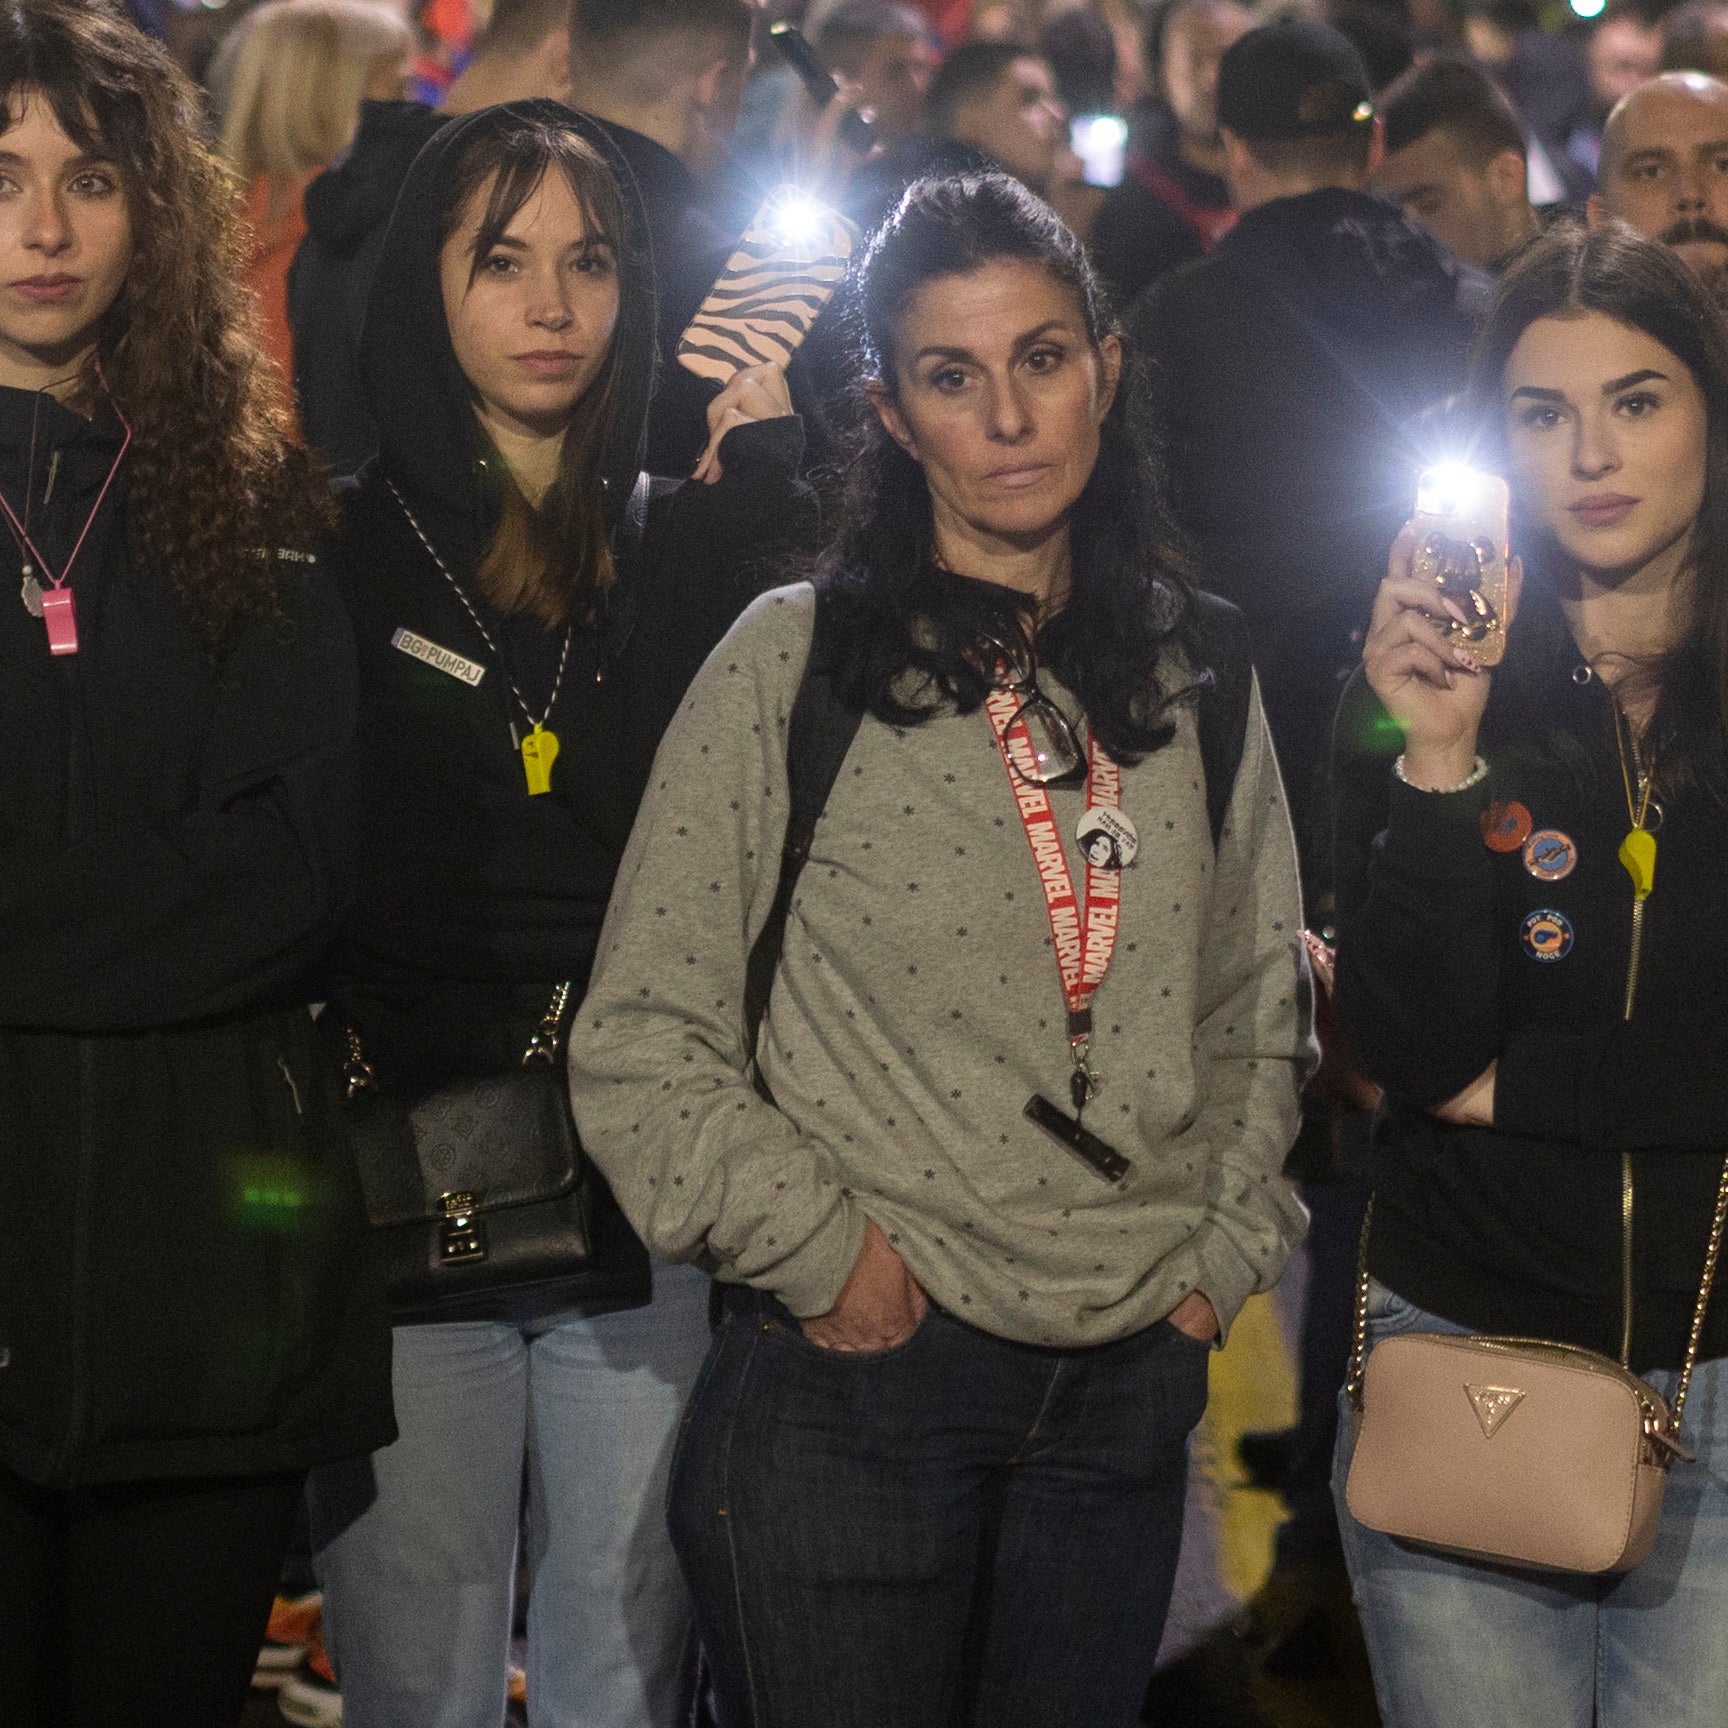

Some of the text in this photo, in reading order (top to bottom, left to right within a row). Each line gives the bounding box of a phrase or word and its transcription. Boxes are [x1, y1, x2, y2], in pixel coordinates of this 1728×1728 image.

[399, 633, 482, 682] BG PUMPAJ
[1026, 821, 1072, 904] MARVEL
[1050, 906, 1081, 991] MARVEL
[1082, 905, 1117, 984] MARVEL
